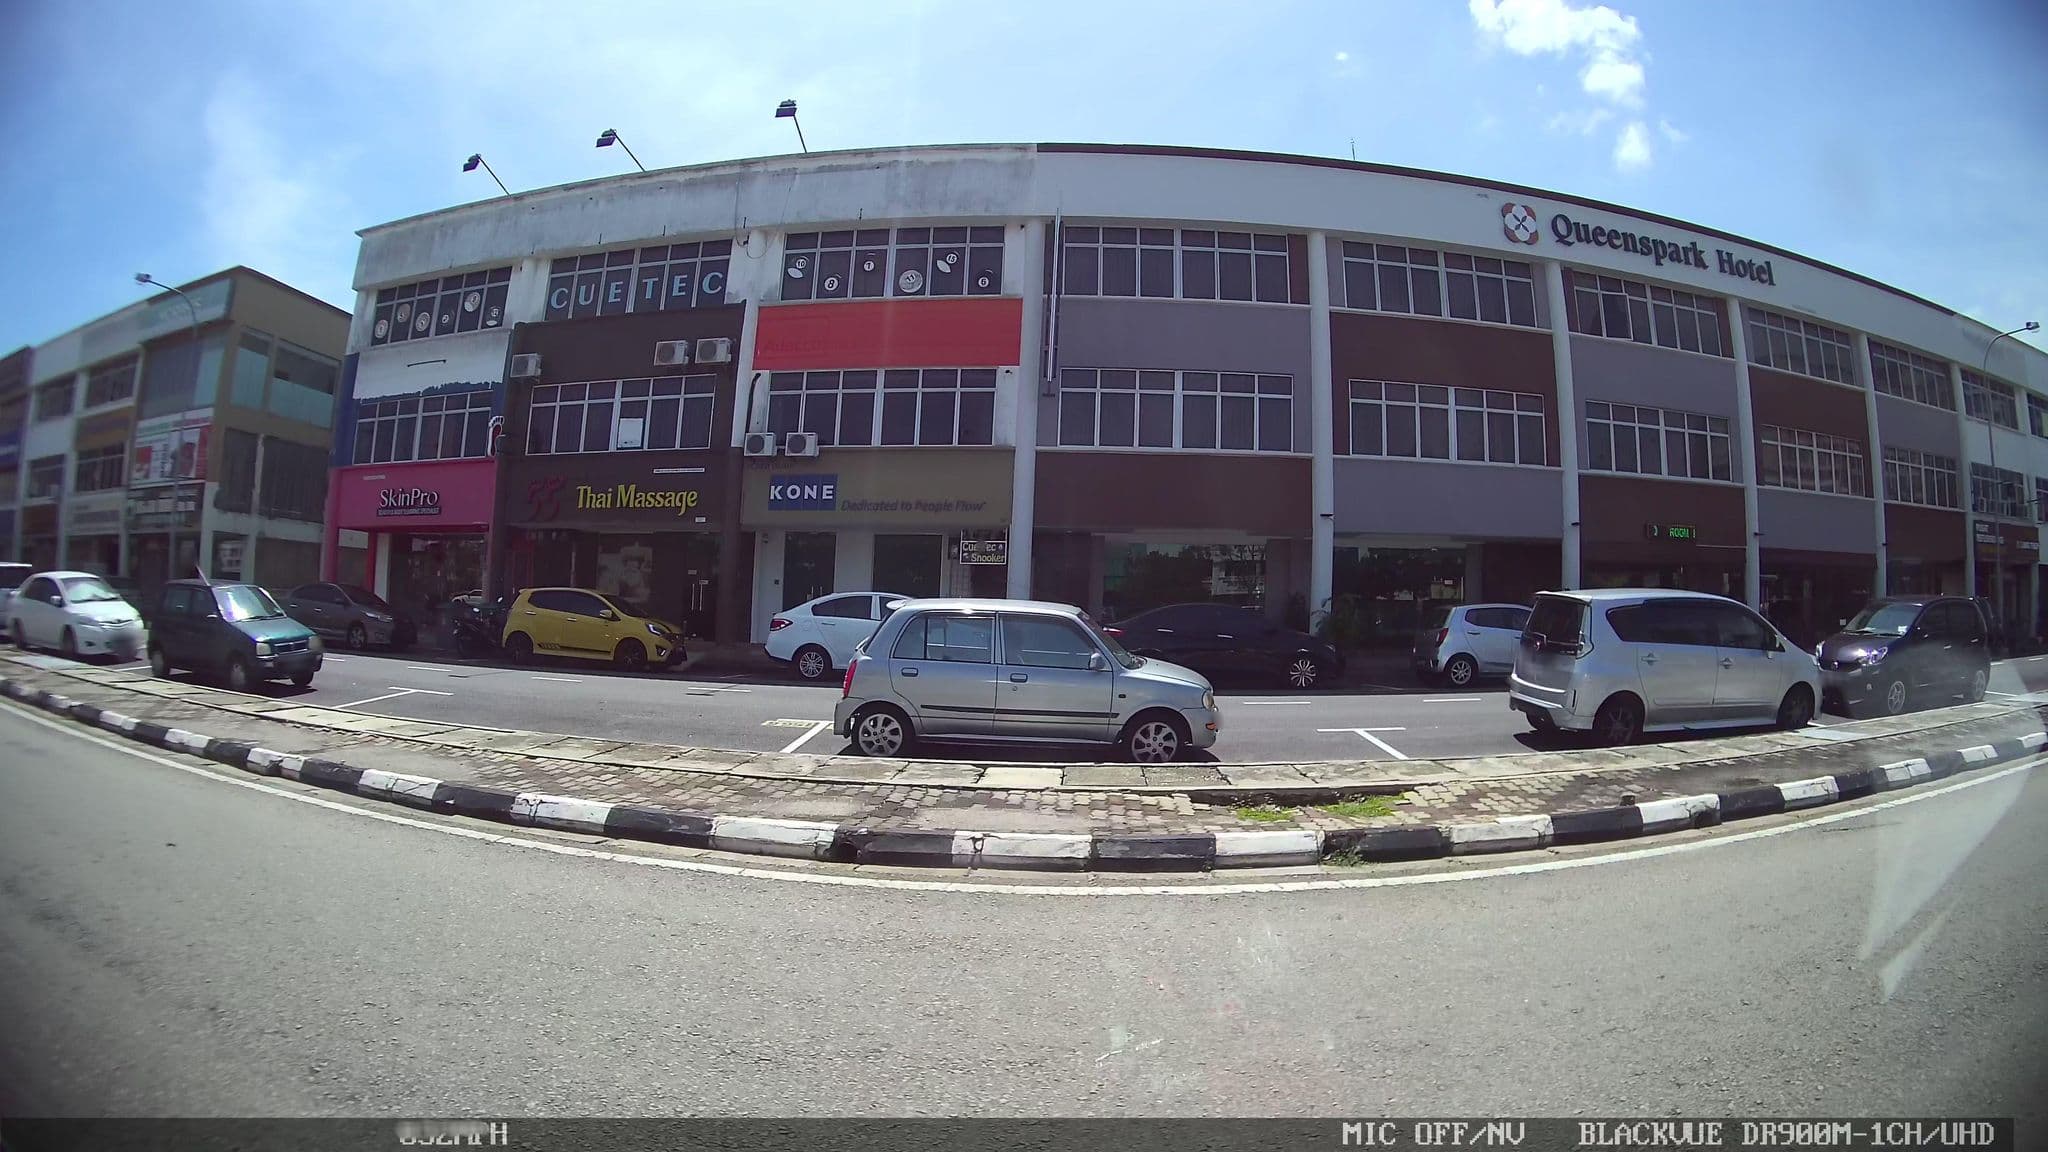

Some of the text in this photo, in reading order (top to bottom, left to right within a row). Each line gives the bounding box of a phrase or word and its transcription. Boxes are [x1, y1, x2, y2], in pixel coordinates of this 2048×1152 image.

[1551, 213, 1777, 286] Queenspark Hotel
[379, 488, 438, 507] SkinPro
[576, 484, 698, 516] Thai Massage
[770, 484, 834, 500] KONE
[841, 500, 898, 512] Dedicated
[901, 501, 912, 511] to
[915, 500, 953, 513] People
[971, 553, 1005, 562] Snooker
